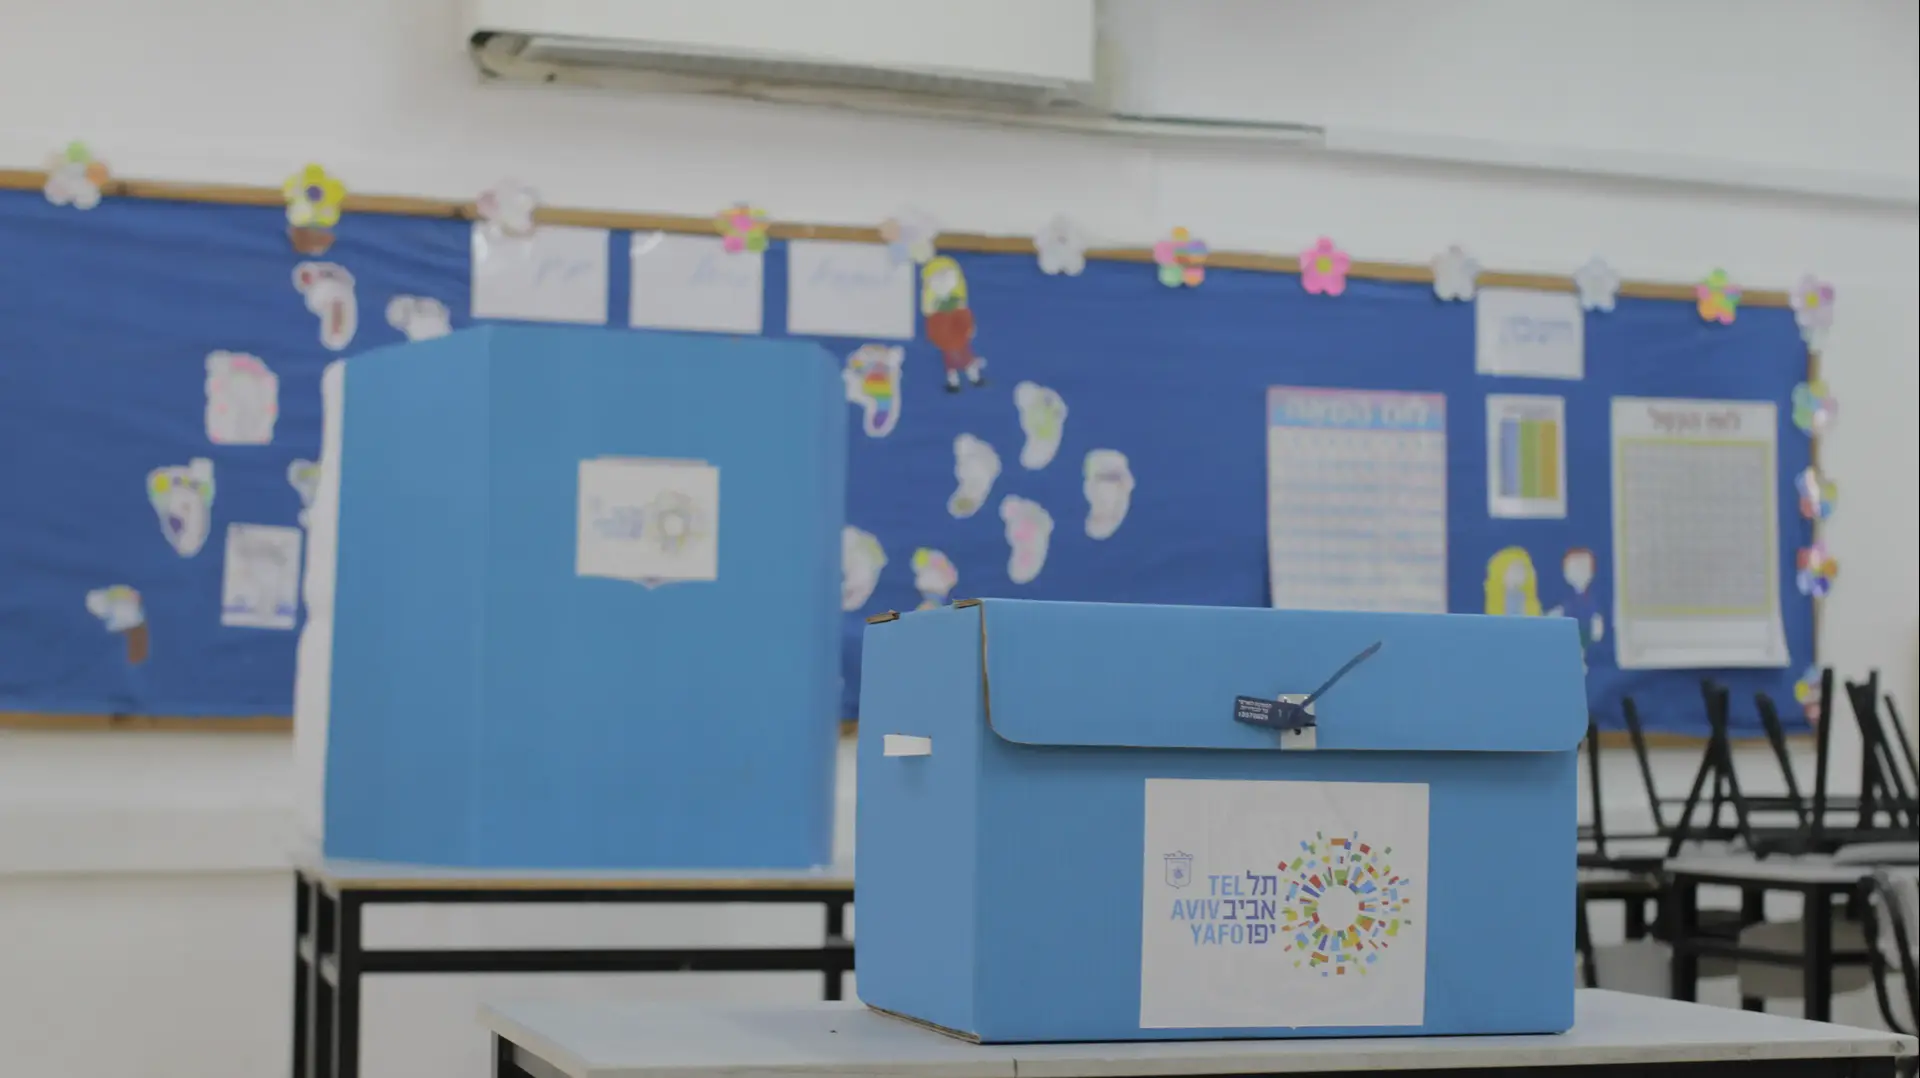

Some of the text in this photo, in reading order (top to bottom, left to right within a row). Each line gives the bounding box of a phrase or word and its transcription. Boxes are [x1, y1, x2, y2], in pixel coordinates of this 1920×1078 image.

[1208, 874, 1244, 896] TEL
[1246, 870, 1278, 896] תל
[1170, 899, 1220, 920] AVIV
[1223, 899, 1276, 920] אביב
[1190, 924, 1244, 946] YAFO
[1247, 923, 1276, 944] יפו
